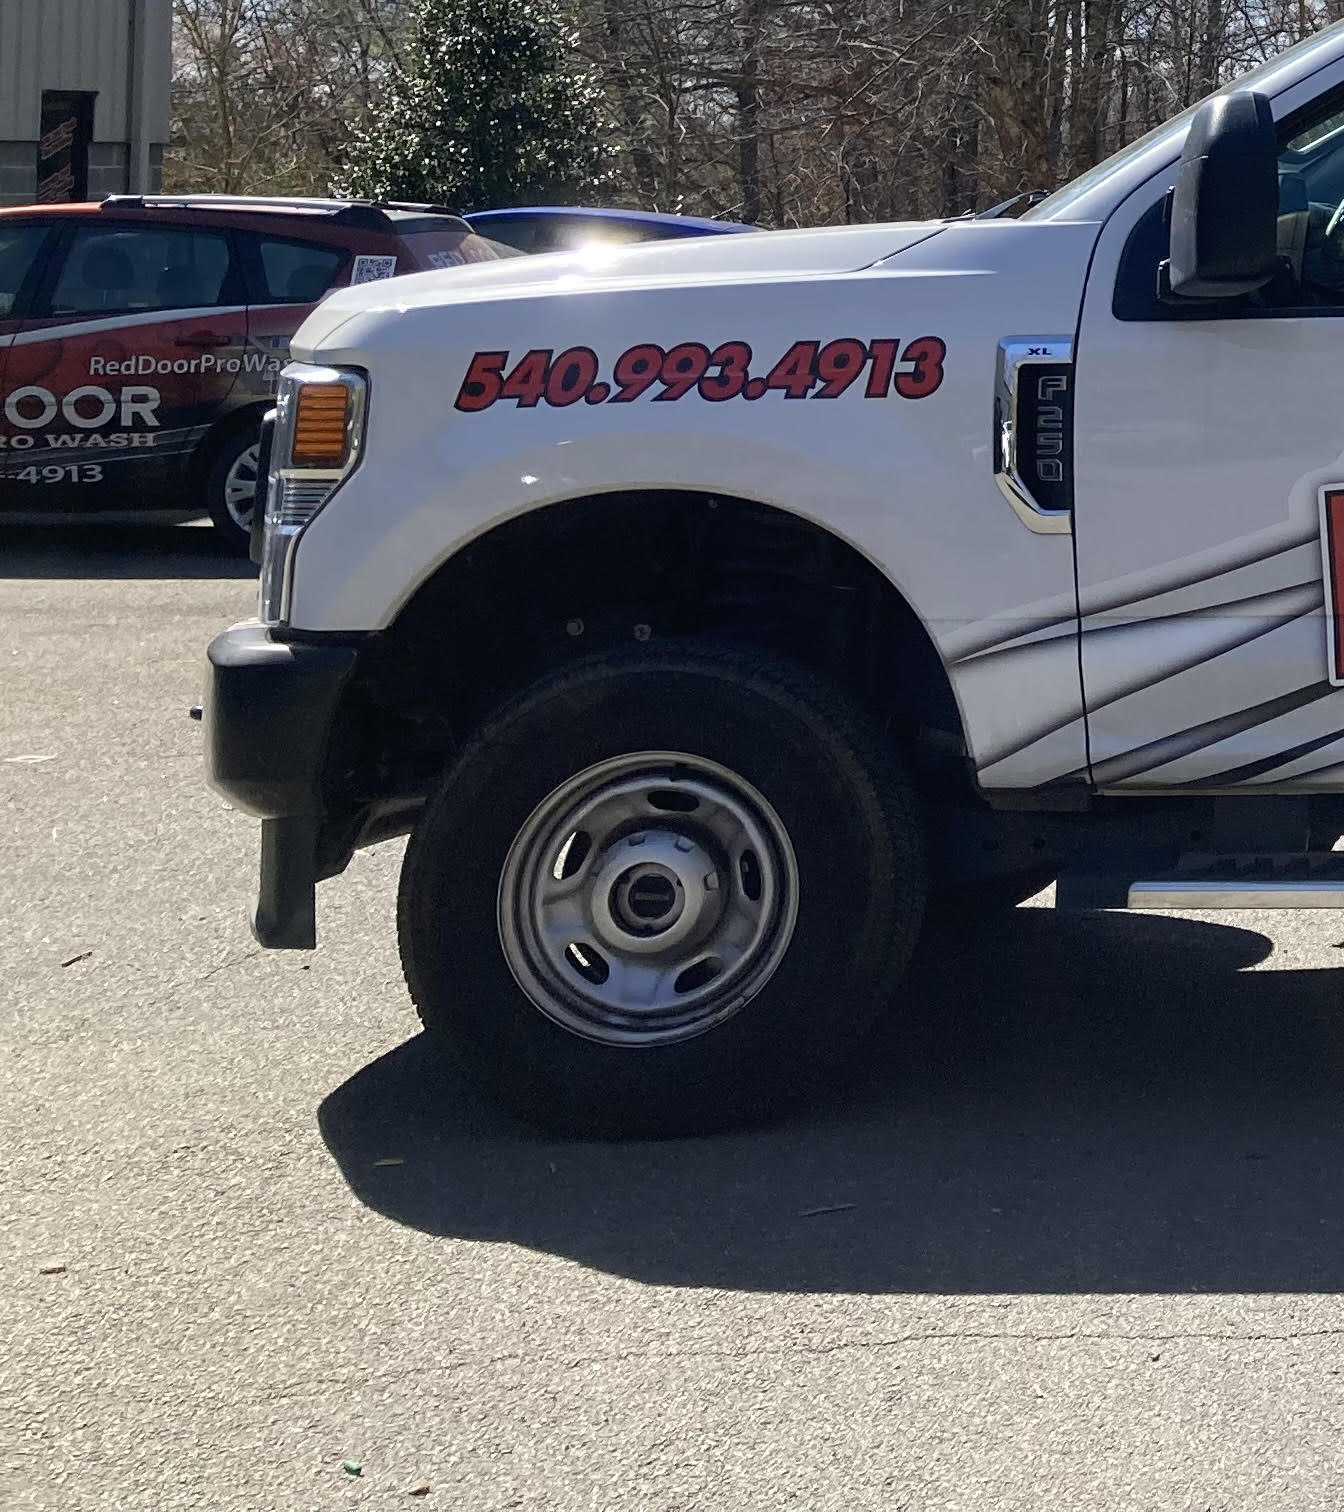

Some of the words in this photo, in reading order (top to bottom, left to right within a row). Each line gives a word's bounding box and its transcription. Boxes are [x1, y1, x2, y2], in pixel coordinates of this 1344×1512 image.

[1028, 347, 1052, 356] XL
[454, 335, 947, 413] 540.993.4913
[4, 385, 161, 429] OOR
[1037, 375, 1067, 482] F250
[45, 432, 157, 449] WASH
